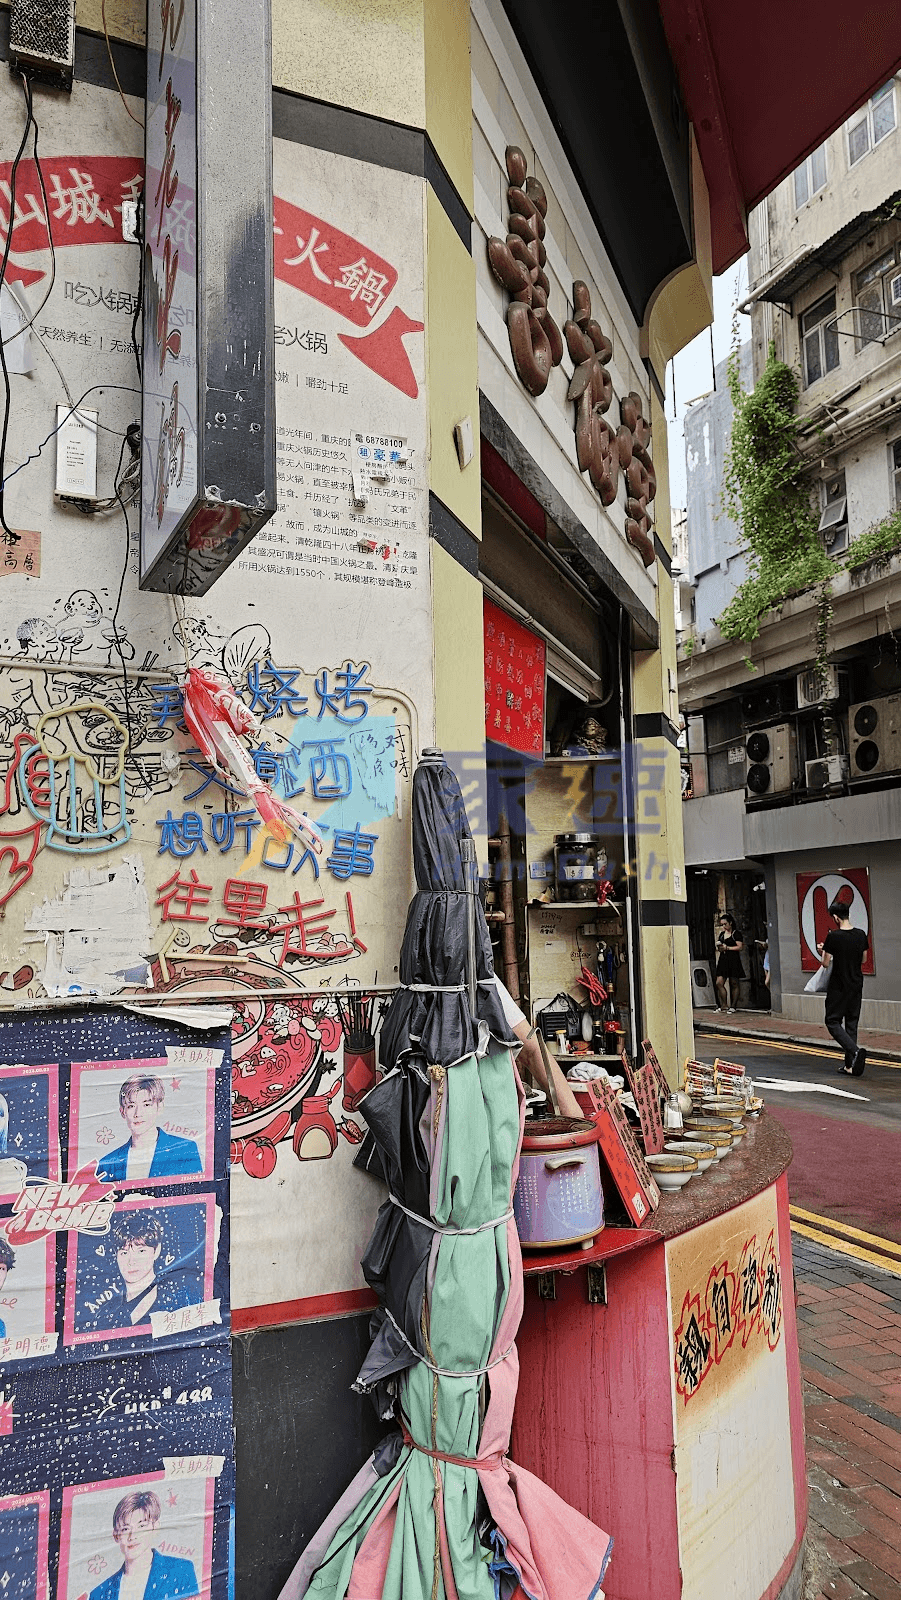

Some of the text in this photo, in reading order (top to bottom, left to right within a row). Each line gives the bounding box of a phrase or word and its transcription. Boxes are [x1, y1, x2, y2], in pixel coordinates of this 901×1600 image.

[38, 324, 92, 347] 天然养生
[304, 375, 350, 396] 嚼劲十足
[364, 434, 404, 449] 68788100
[163, 1121, 199, 1137] AIDEN
[15, 1183, 91, 1212] NEW
[25, 1203, 114, 1232] BOMB
[88, 1285, 121, 1314] ANDY
[158, 1540, 196, 1556] AIDEN
